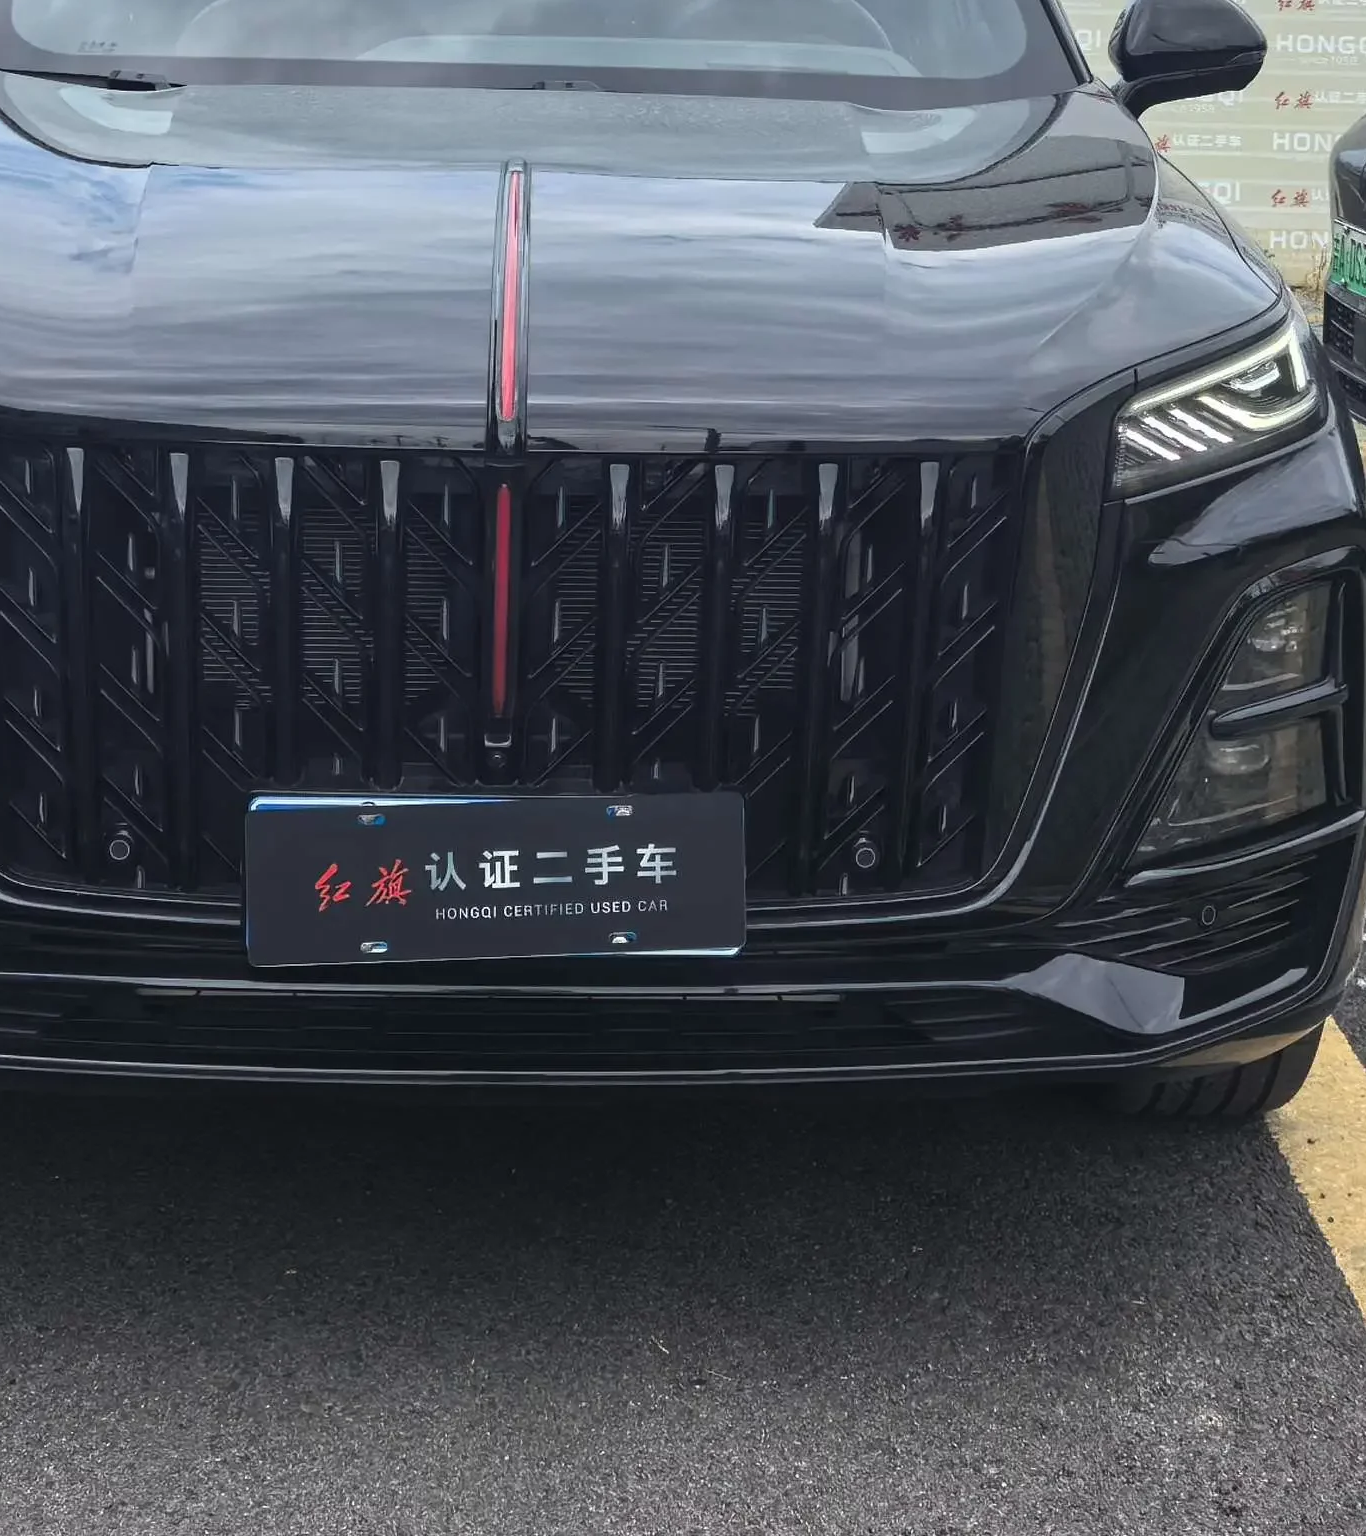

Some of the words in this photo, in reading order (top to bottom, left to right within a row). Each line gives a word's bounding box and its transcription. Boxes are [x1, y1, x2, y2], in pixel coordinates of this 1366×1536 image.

[1156, 133, 1242, 153] 旗认证二手车
[435, 905, 498, 920] HONGQI
[503, 902, 585, 918] CERTIFIED
[591, 900, 632, 915] USED
[637, 899, 669, 913] CAR
